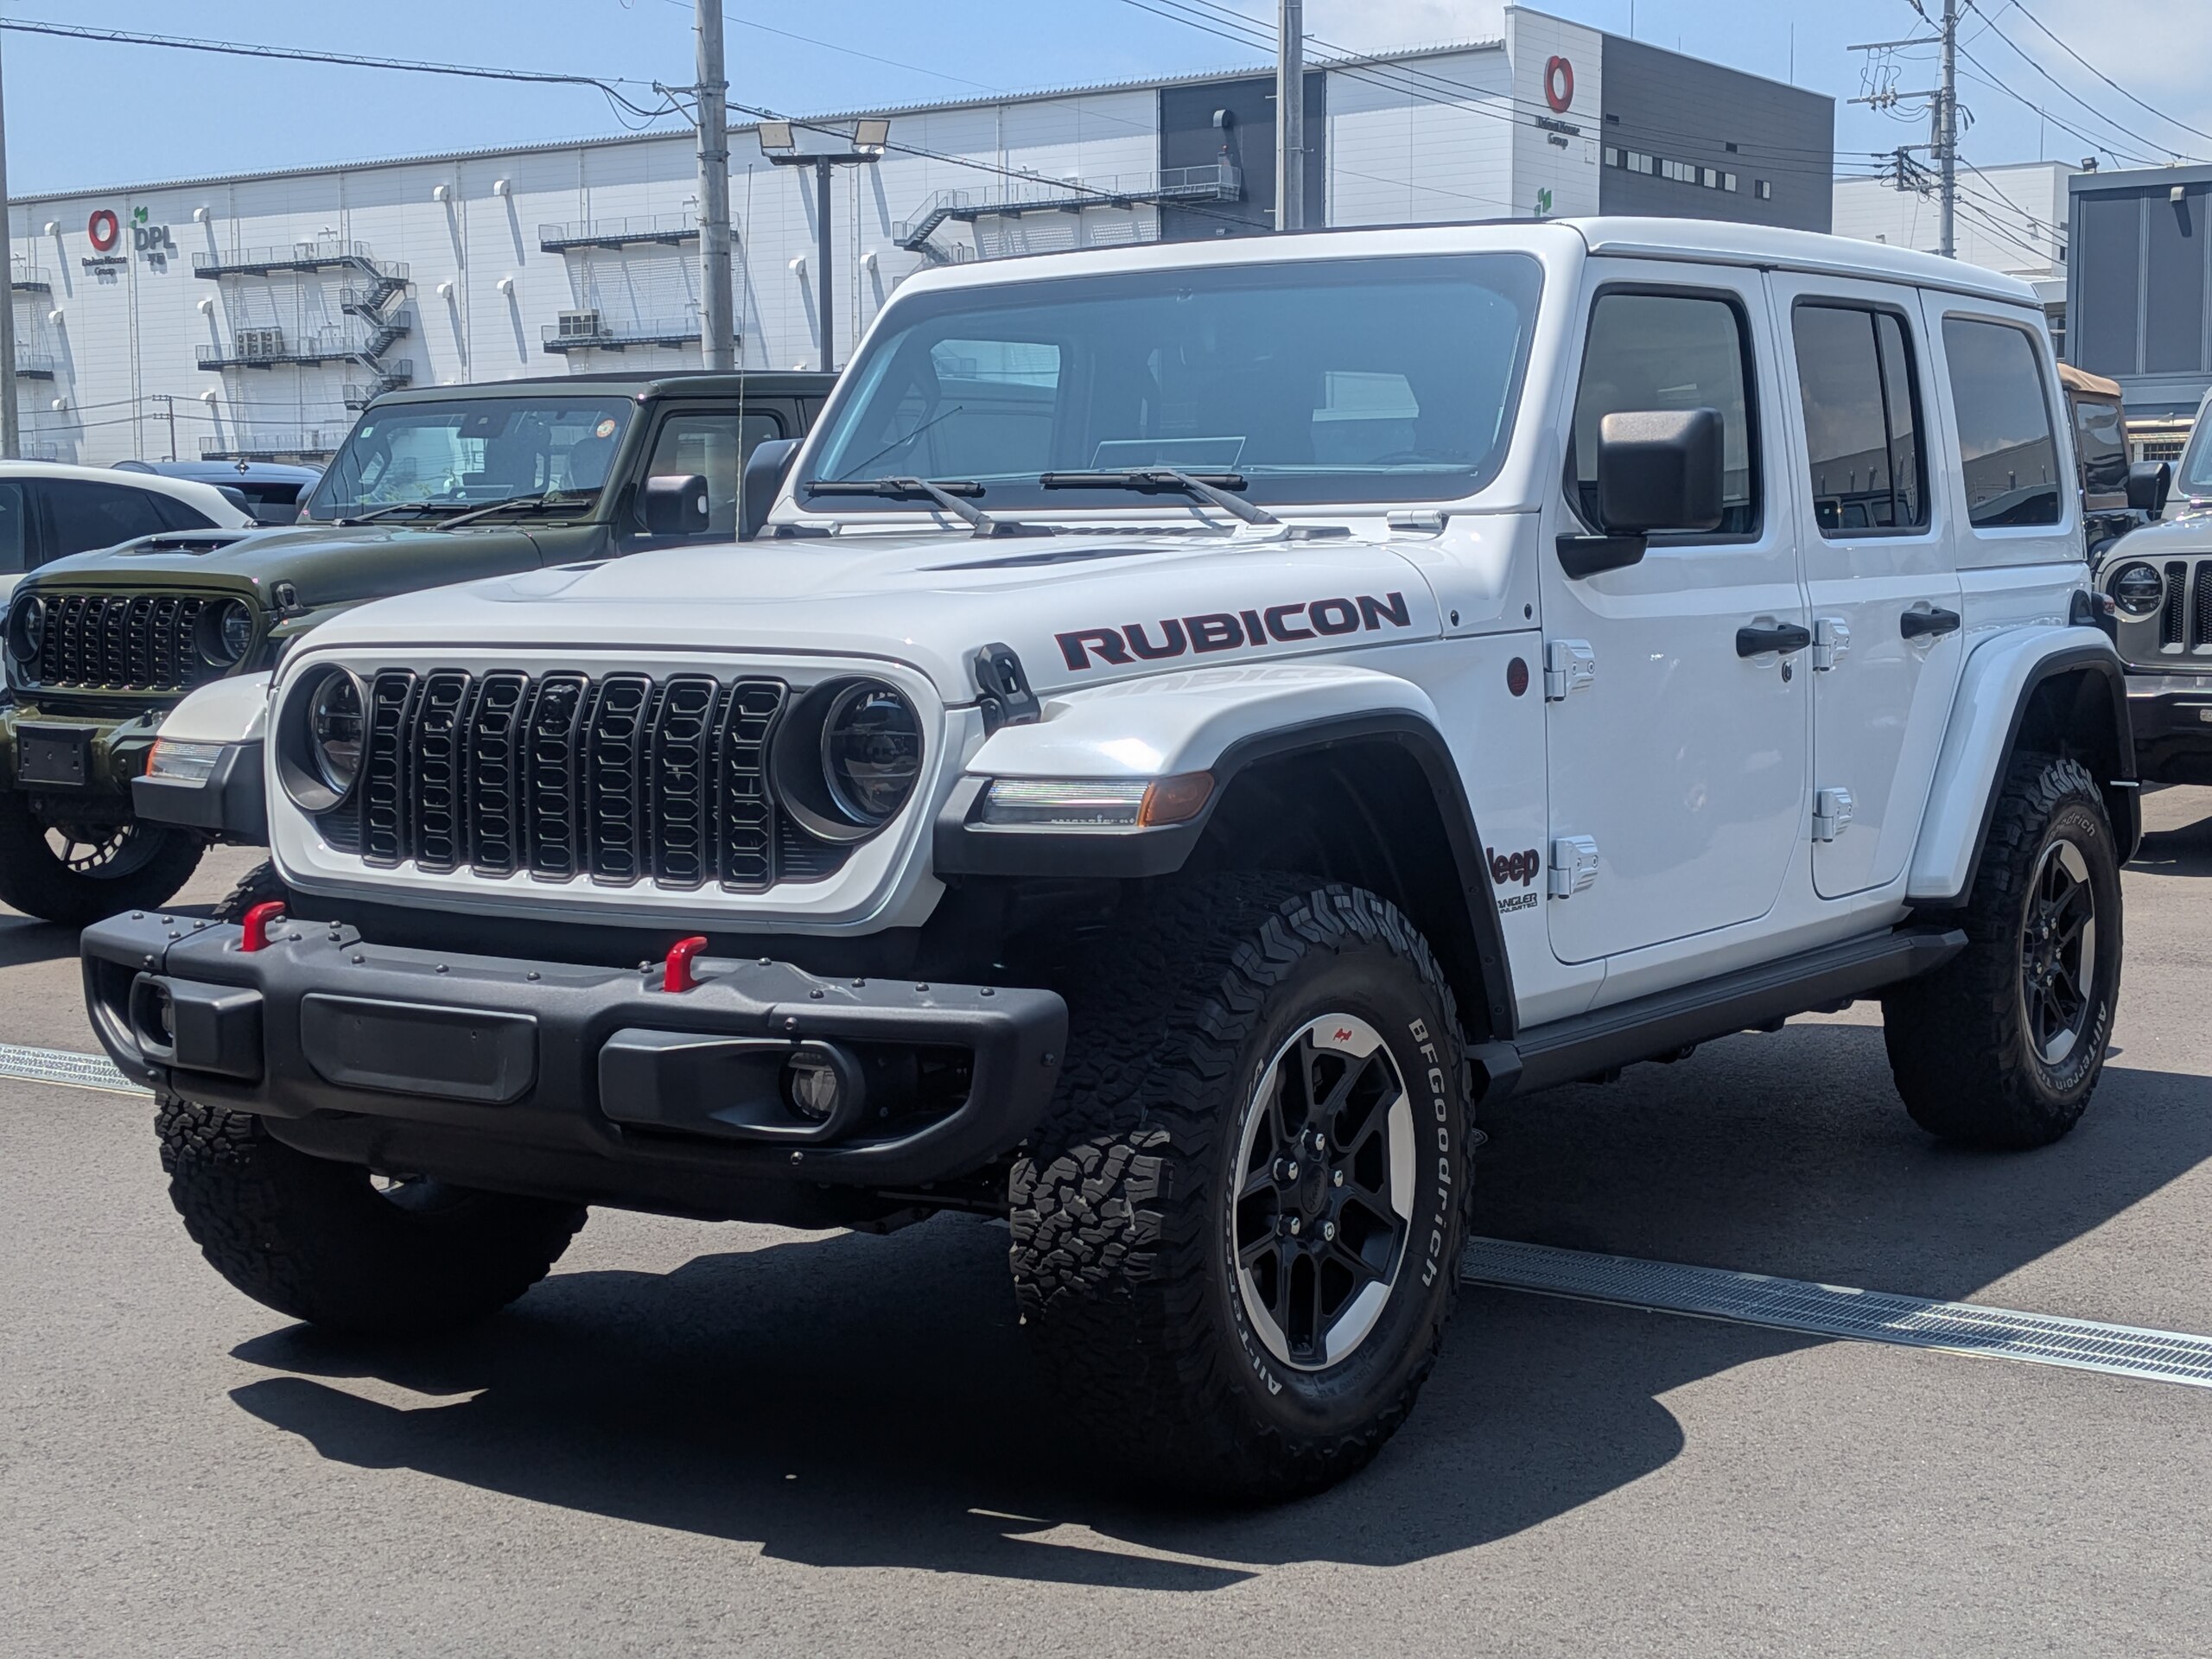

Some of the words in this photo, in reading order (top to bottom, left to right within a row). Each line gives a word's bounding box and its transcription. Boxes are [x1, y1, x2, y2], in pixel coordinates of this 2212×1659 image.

[135, 226, 177, 251] DPL
[1054, 591, 1412, 671] RUBICON
[1499, 902, 1538, 914] NLIMITED
[1408, 1018, 1452, 1287] BFGoodrich
